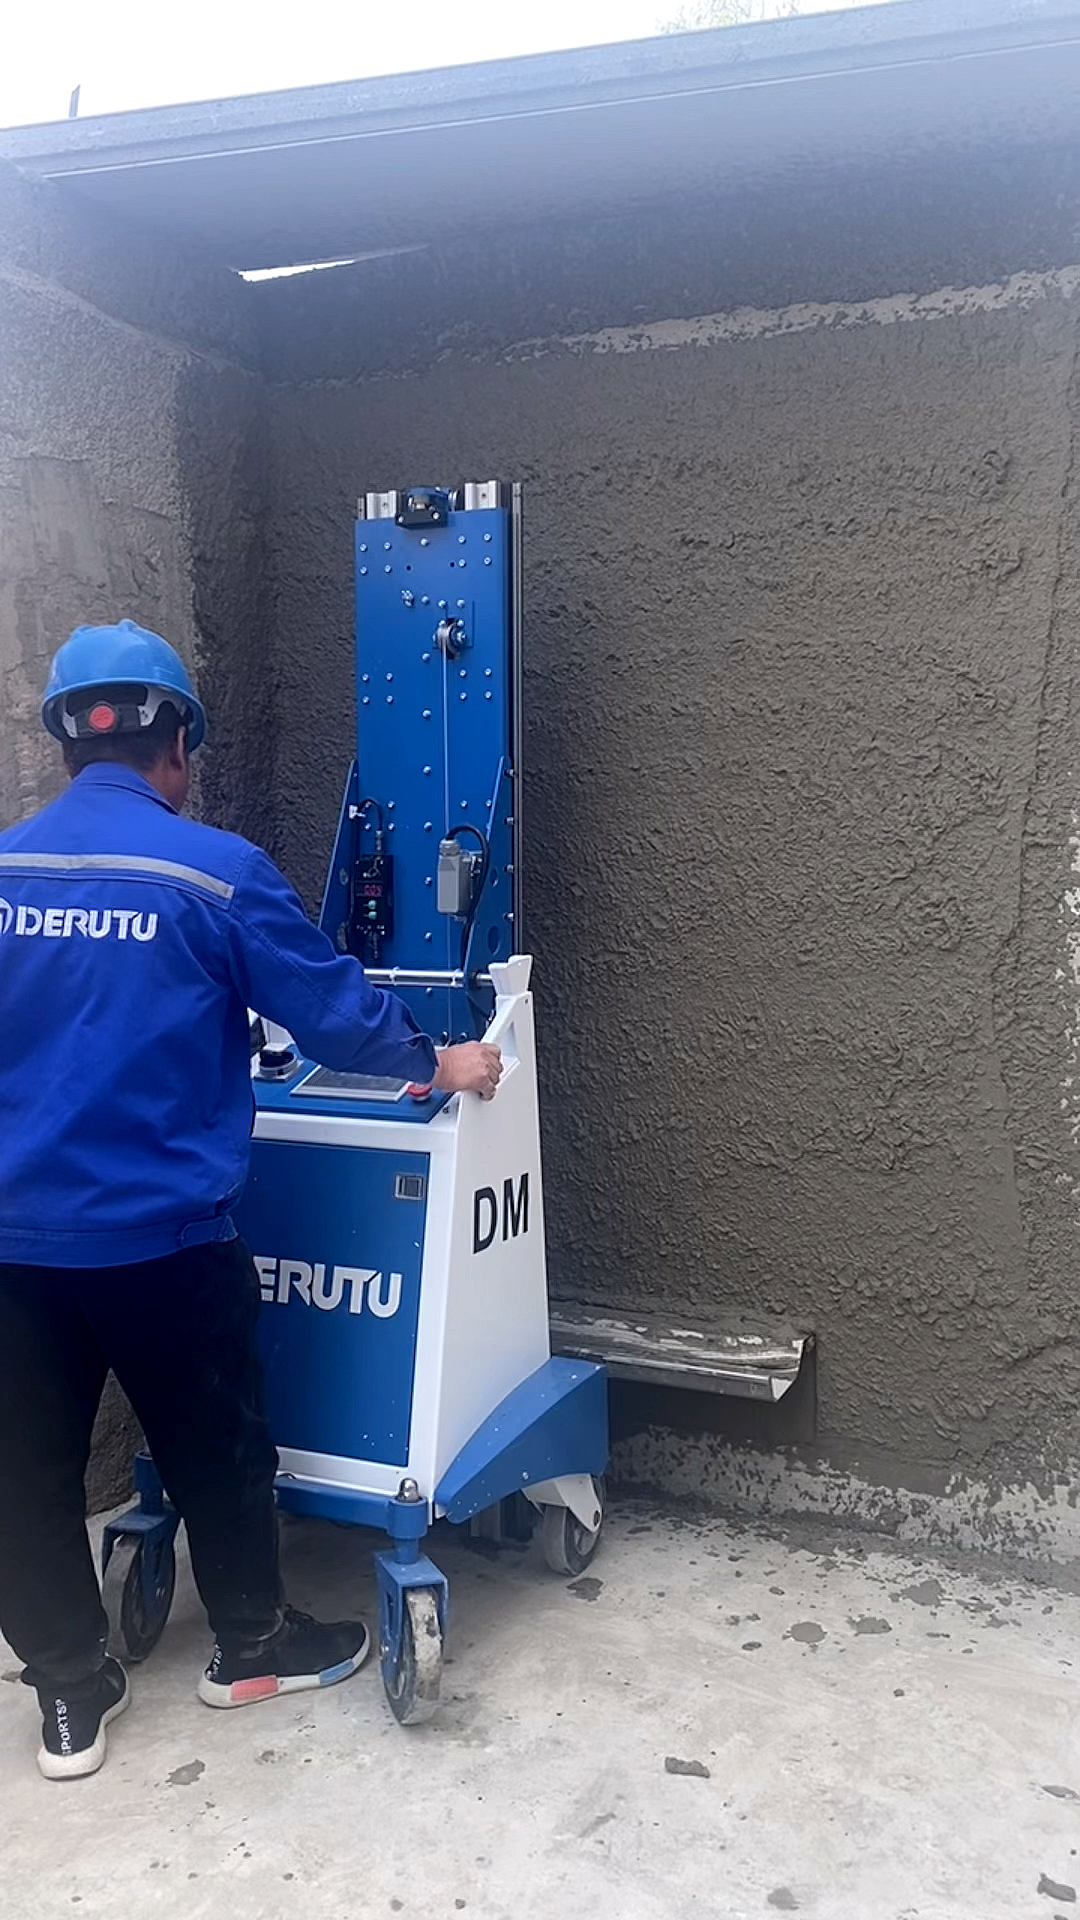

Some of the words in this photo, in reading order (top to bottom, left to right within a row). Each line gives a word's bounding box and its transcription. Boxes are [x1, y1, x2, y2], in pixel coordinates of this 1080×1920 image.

[15, 905, 158, 942] DERUTU
[473, 1172, 529, 1255] DM
[252, 1255, 403, 1319] ERUTU
